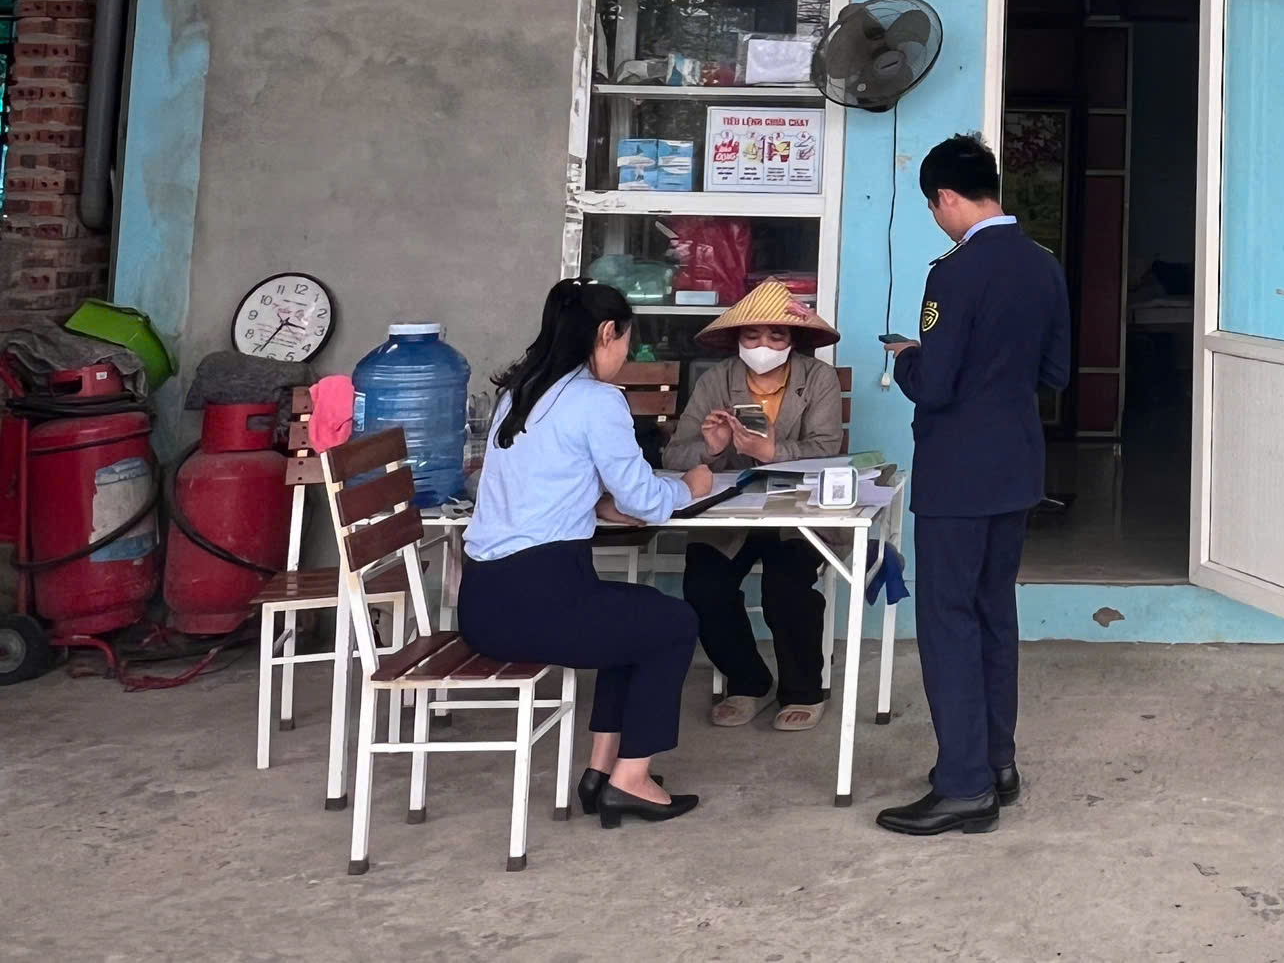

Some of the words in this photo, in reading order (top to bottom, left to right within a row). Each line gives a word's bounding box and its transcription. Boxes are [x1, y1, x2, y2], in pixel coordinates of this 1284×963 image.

[277, 285, 285, 294] 11
[295, 284, 308, 295] 12
[261, 295, 272, 305] 10
[314, 293, 319, 302] 1
[248, 310, 258, 320] 9
[317, 309, 327, 318] 2
[245, 329, 254, 339] 8
[314, 326, 325, 336] 3
[252, 343, 262, 353] 7
[302, 344, 311, 352] 4
